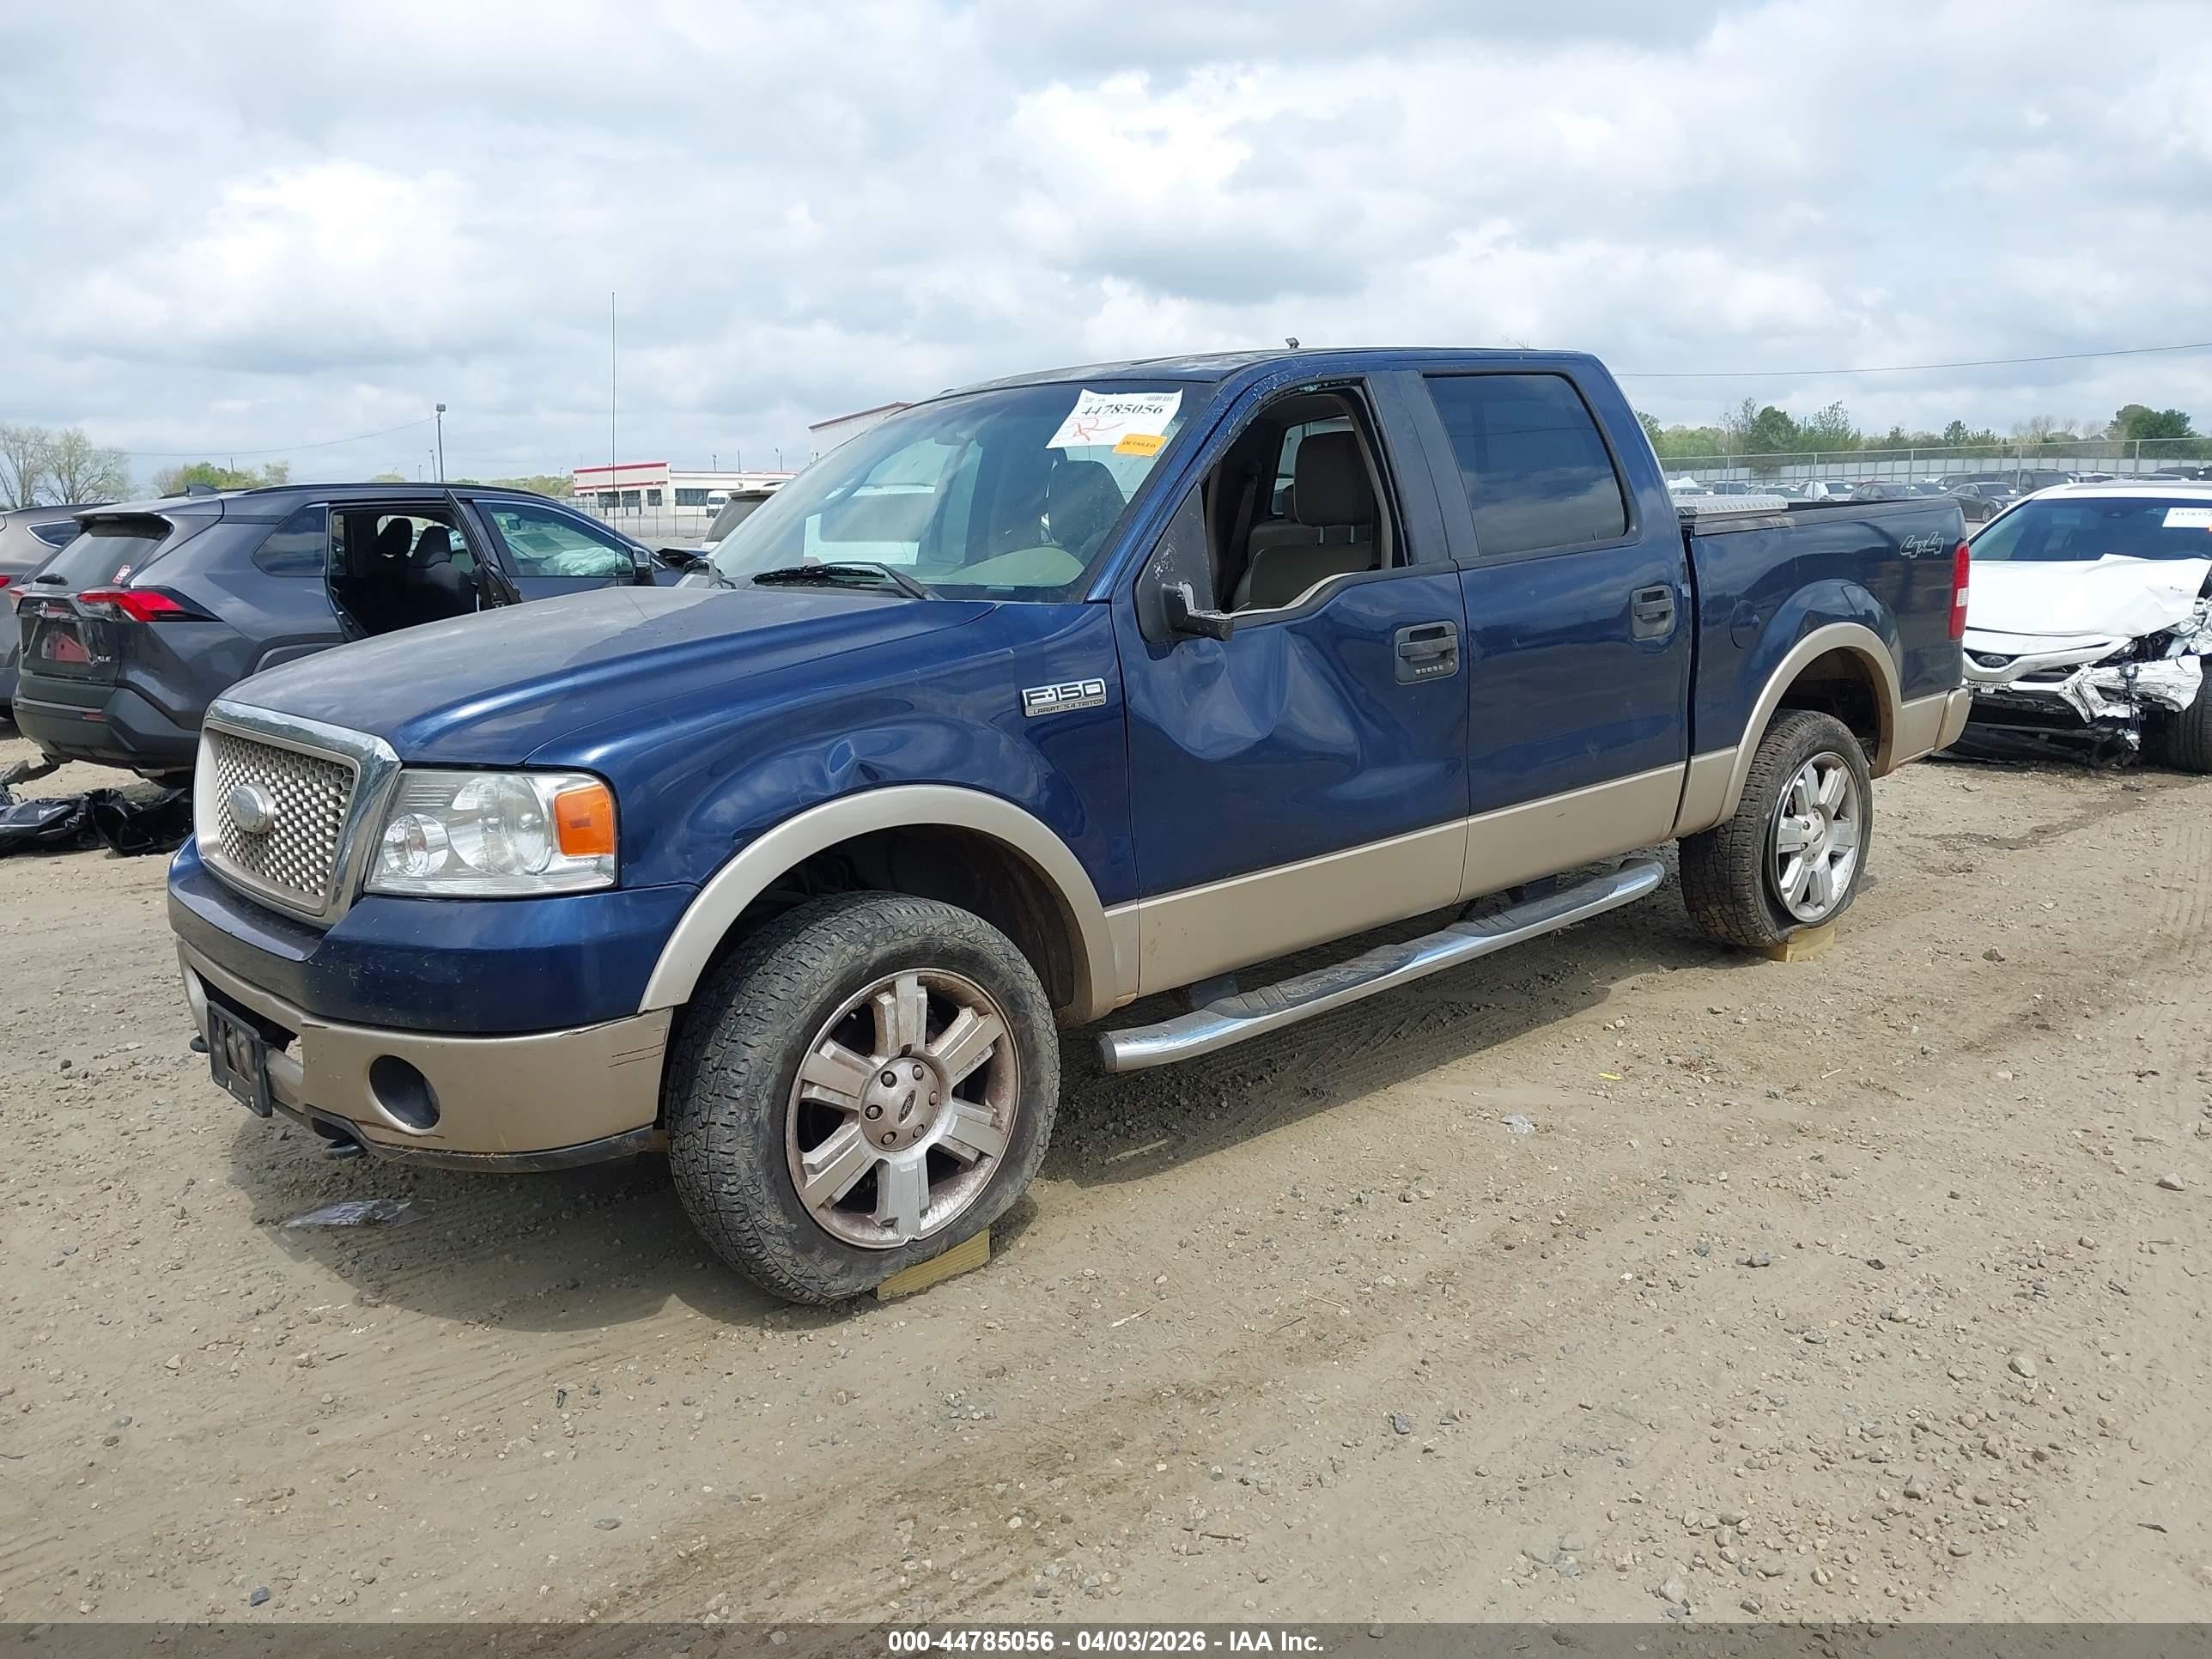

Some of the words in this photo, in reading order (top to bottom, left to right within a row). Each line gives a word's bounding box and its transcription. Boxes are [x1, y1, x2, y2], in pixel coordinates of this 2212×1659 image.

[1081, 404, 1167, 416] 44785056
[1900, 531, 1944, 559] 4x4
[1033, 704, 1060, 715] LARIAT
[1079, 698, 1104, 708] TRITON
